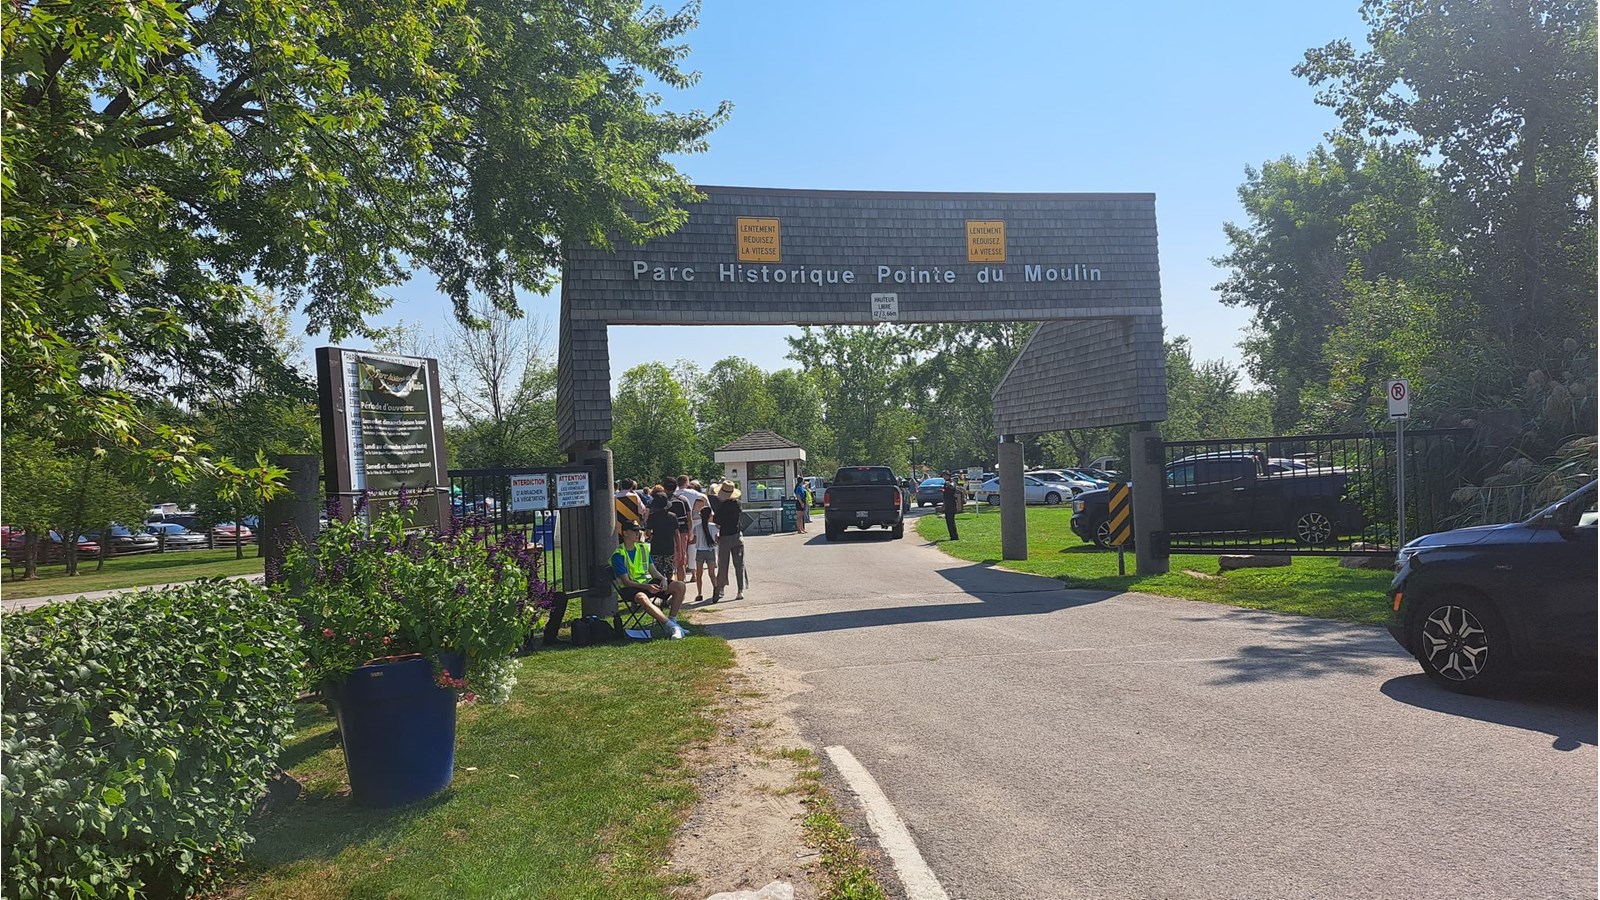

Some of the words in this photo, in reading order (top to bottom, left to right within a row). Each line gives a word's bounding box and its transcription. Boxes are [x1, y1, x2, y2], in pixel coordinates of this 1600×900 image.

[752, 247, 777, 255] VITESSE
[632, 260, 695, 282] Parc
[719, 263, 855, 287] Historique
[877, 265, 956, 284] Pointe
[976, 266, 1004, 284] du
[1024, 264, 1101, 282] Moulin
[513, 478, 545, 486] INTERDICTION
